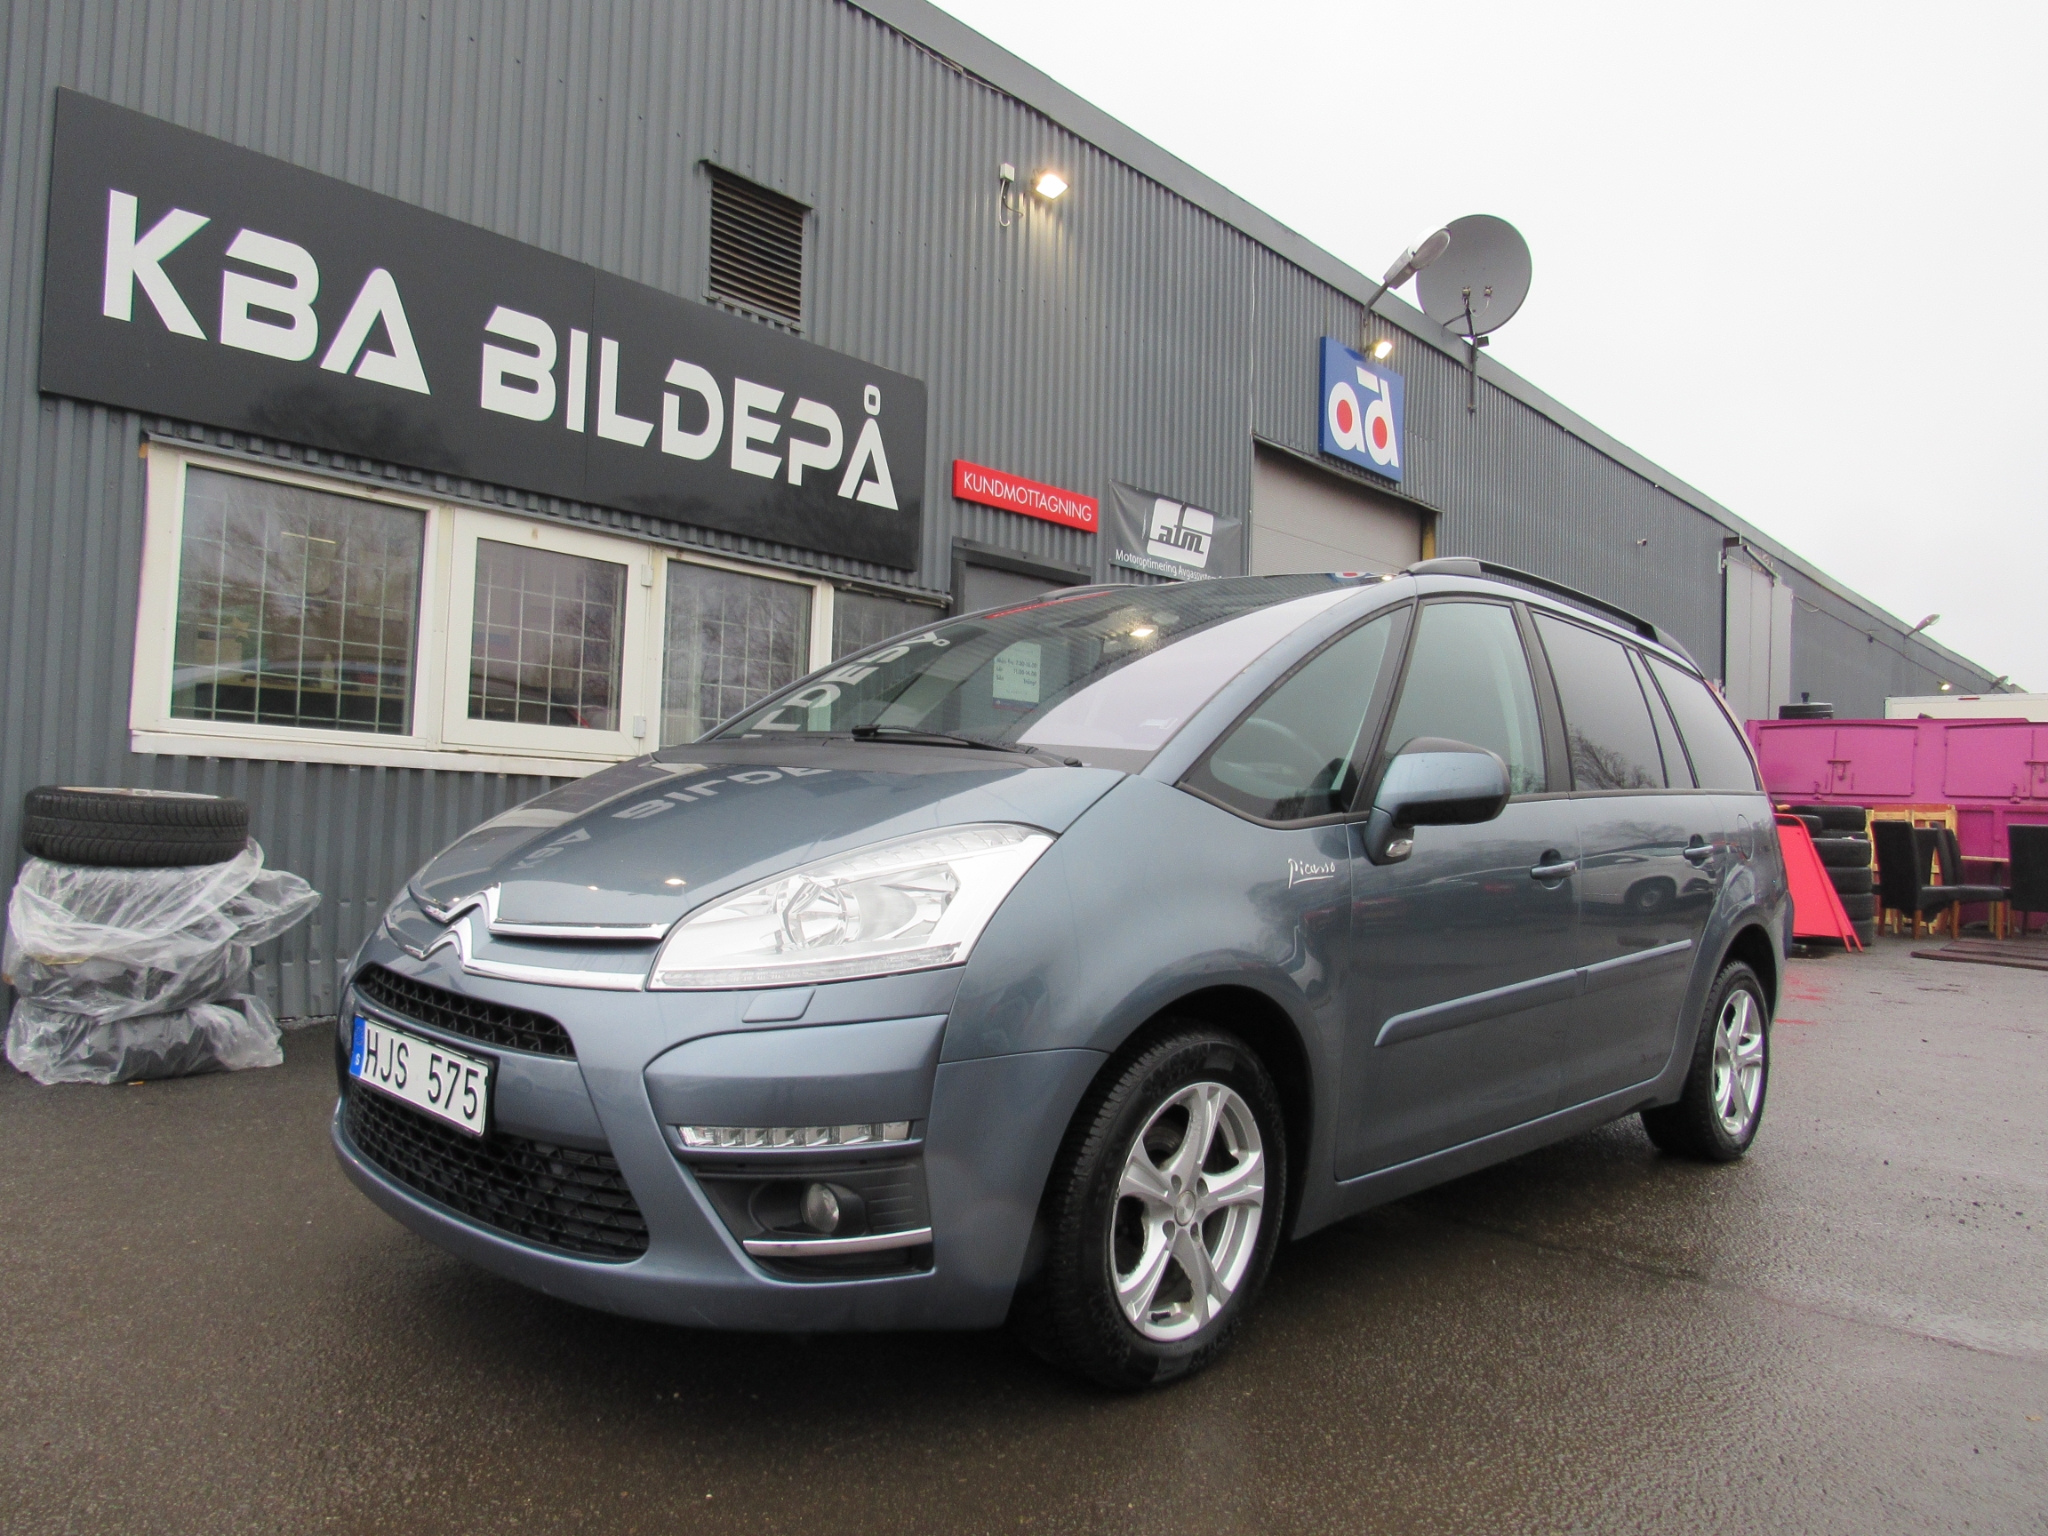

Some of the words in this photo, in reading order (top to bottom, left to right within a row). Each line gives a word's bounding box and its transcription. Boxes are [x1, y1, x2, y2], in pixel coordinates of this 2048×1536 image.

[103, 189, 431, 395] KBA
[481, 306, 899, 511] BILDEPÅ
[963, 471, 1092, 522] KUNDMOTTAGNING
[1115, 549, 1178, 577] Motoroptimering
[355, 1053, 361, 1066] S
[364, 1028, 409, 1090] HJS
[428, 1053, 479, 1120] 575
